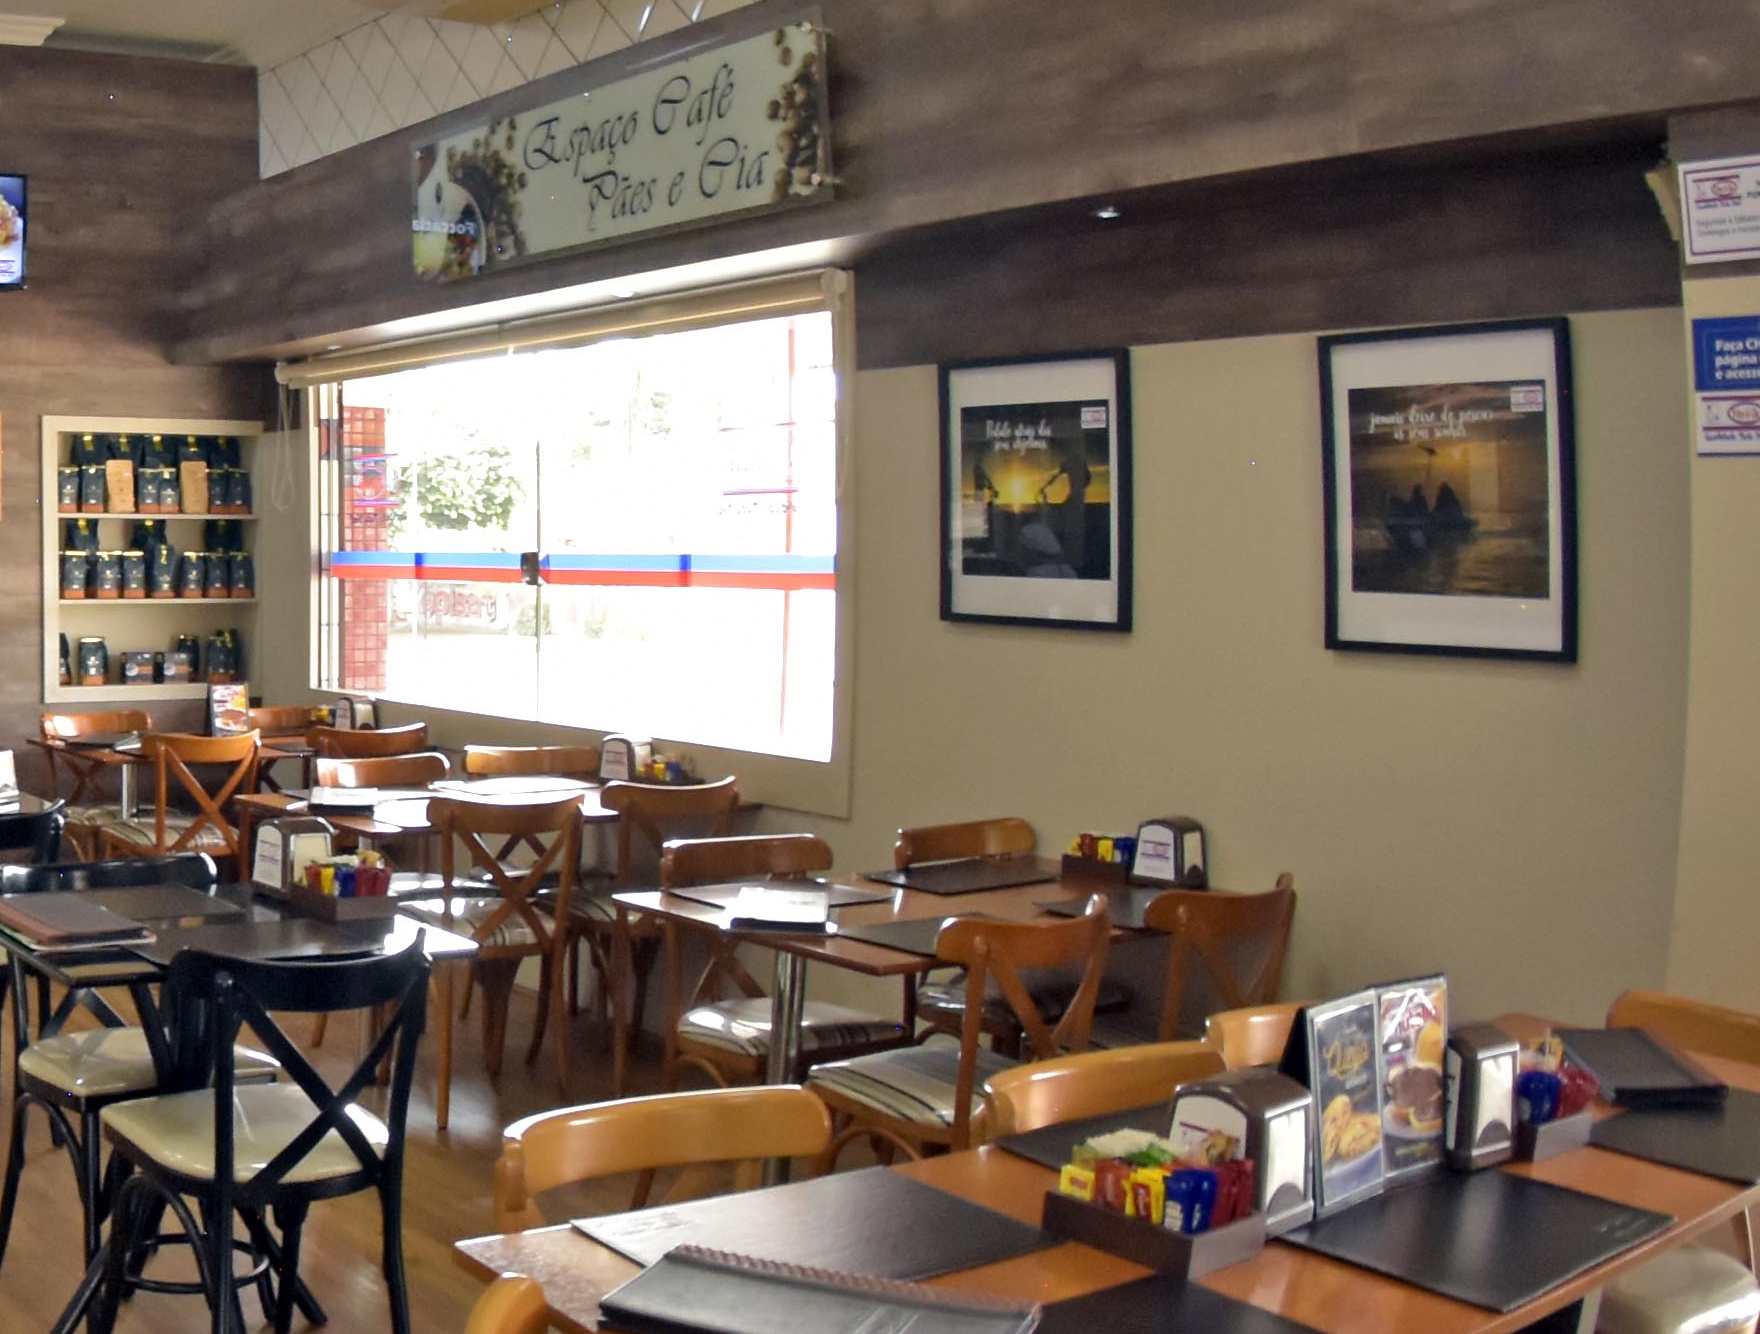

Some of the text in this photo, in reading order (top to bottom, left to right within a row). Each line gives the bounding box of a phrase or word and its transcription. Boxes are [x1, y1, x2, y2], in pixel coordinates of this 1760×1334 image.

[524, 63, 735, 177] Espaço Café
[582, 136, 770, 233] Pães e Cia
[1715, 339, 1744, 353] Faça
[1715, 354, 1757, 370] página
